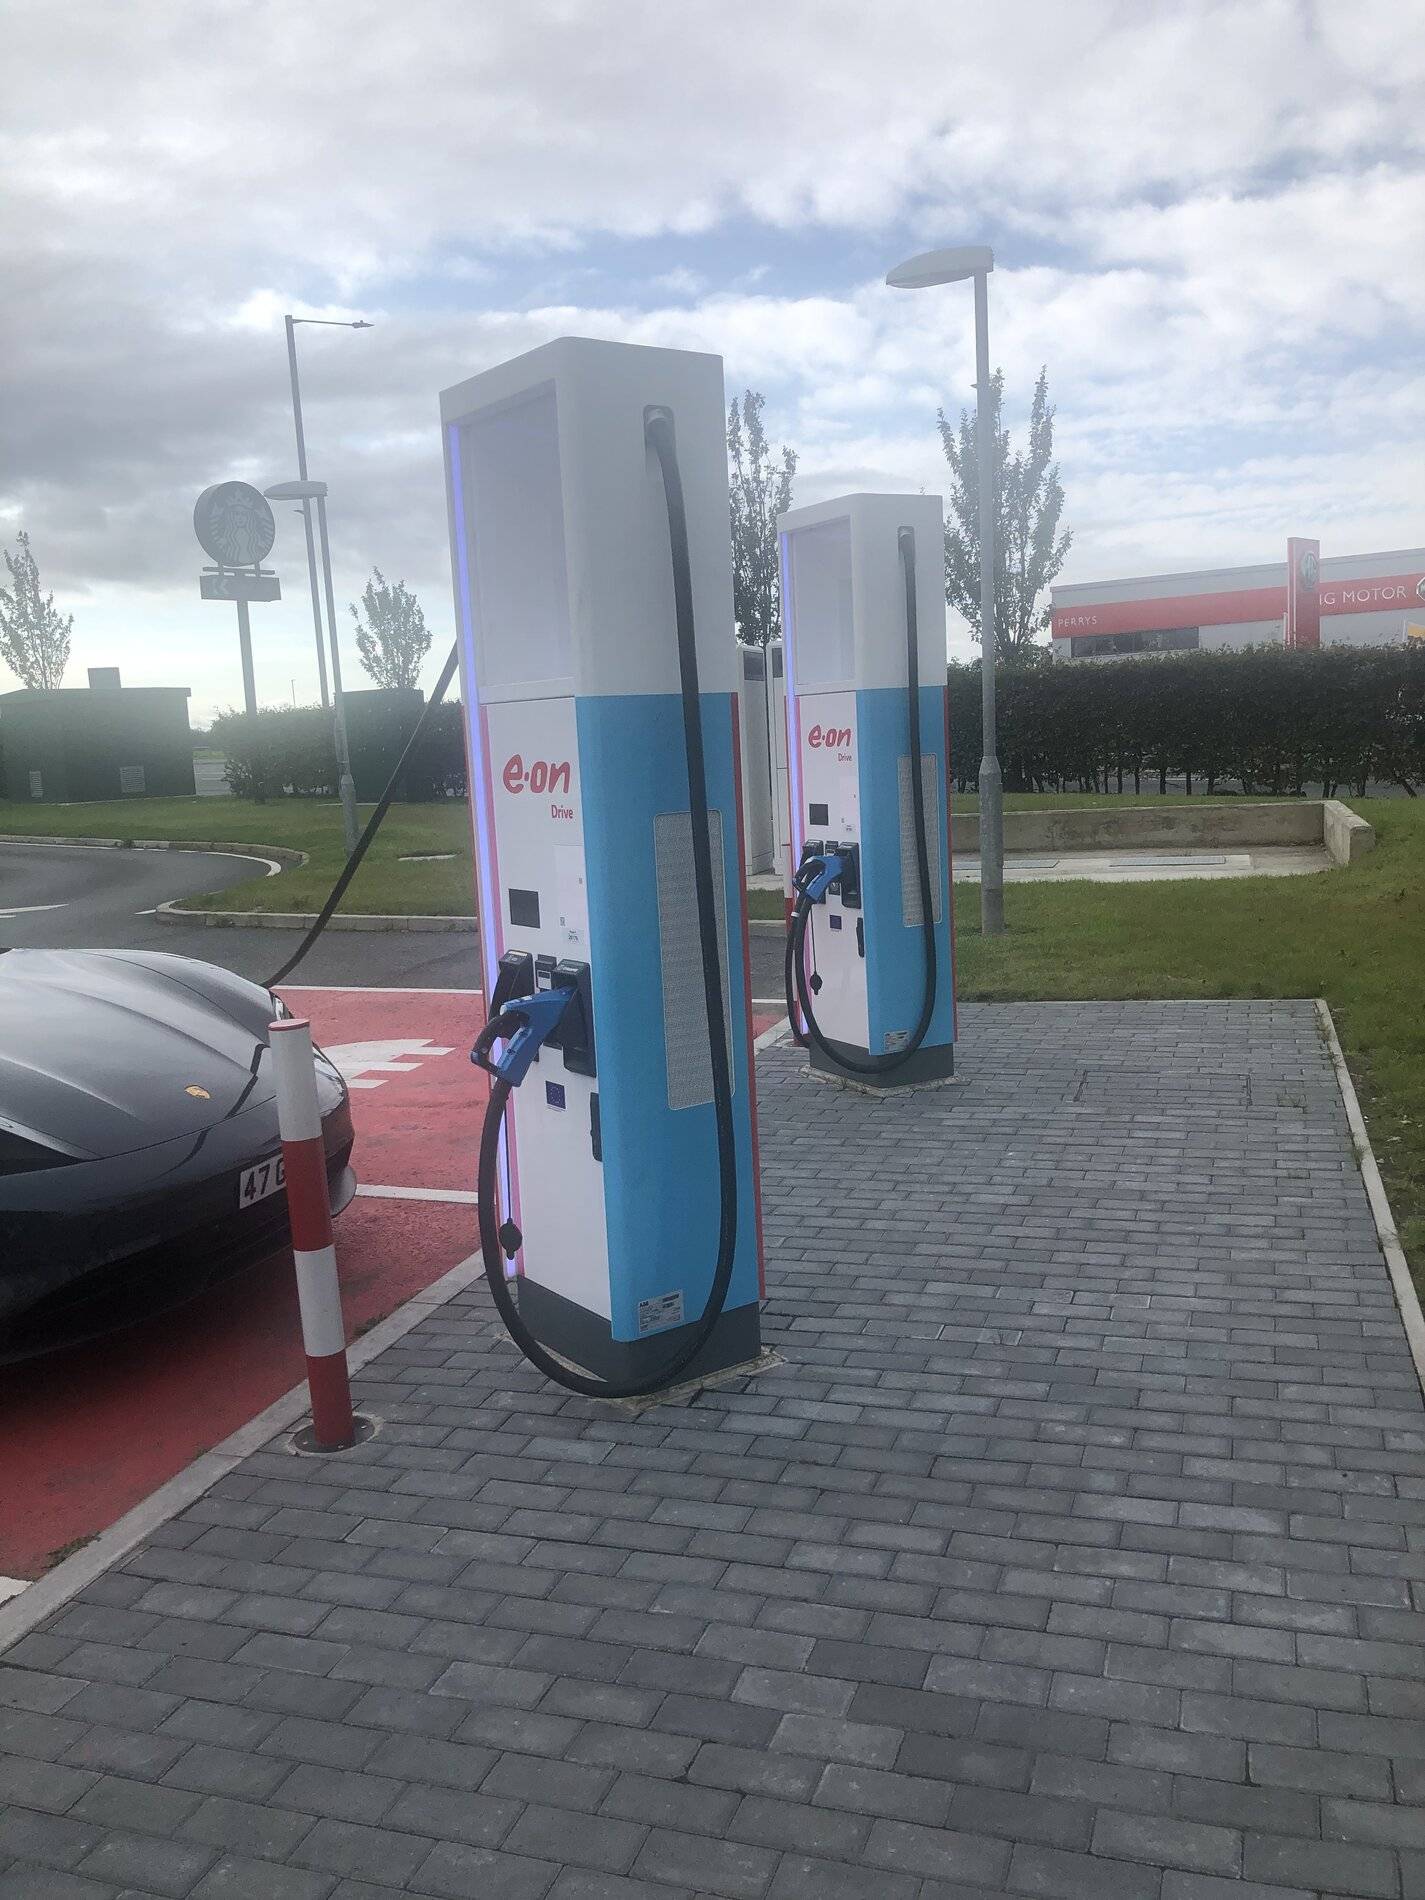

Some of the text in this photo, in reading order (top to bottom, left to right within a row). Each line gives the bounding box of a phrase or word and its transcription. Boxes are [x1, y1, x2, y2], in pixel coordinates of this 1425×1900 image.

[1320, 592, 1335, 605] G
[1343, 586, 1407, 603] MOTOR
[1058, 616, 1097, 628] PERRYS
[551, 804, 574, 819] Drive
